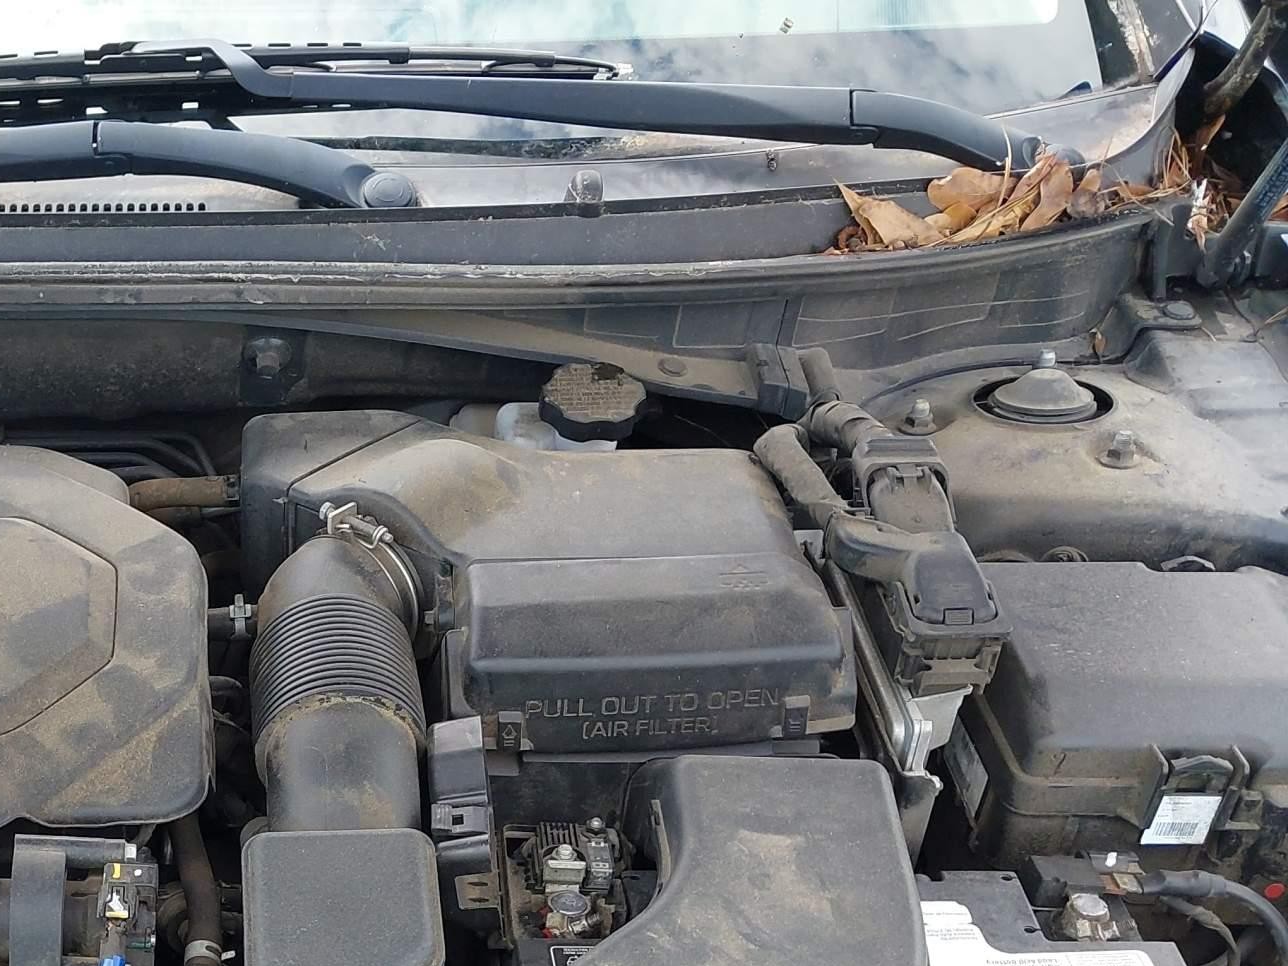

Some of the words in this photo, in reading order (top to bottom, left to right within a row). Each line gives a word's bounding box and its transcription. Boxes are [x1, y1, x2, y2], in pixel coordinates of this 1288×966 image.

[525, 698, 593, 719] PULL
[601, 696, 658, 715] OUT
[664, 693, 698, 712] TO
[707, 687, 779, 710] OPEN
